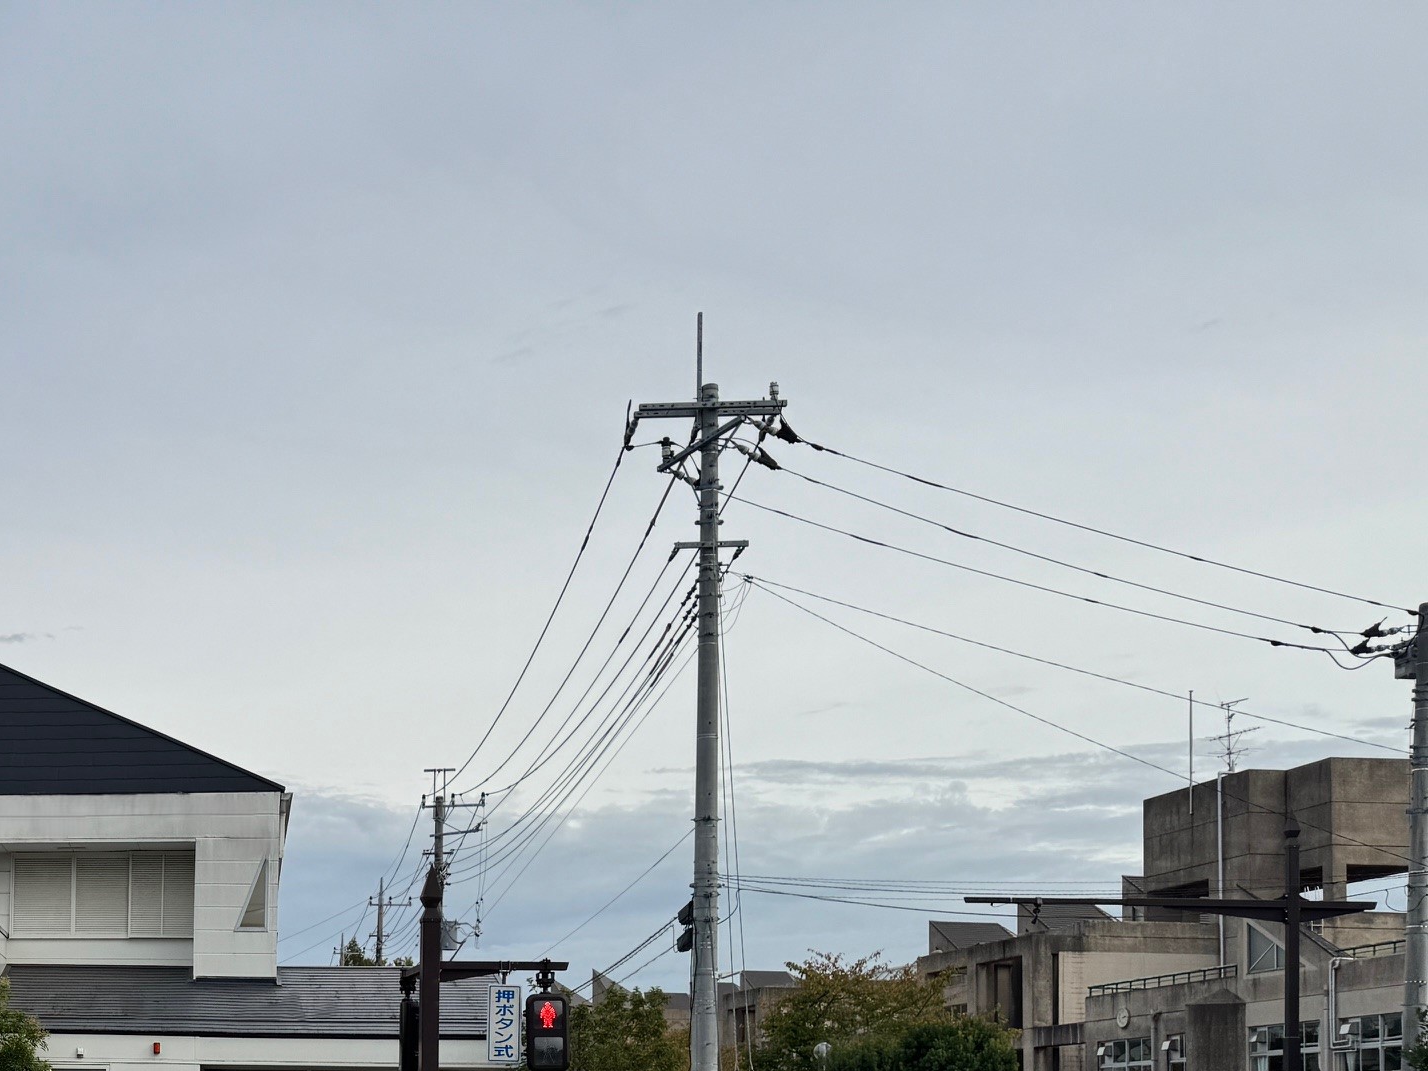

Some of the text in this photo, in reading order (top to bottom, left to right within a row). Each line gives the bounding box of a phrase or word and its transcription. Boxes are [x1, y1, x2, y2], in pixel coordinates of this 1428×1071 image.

[494, 989, 515, 1059] 押ボタン式
